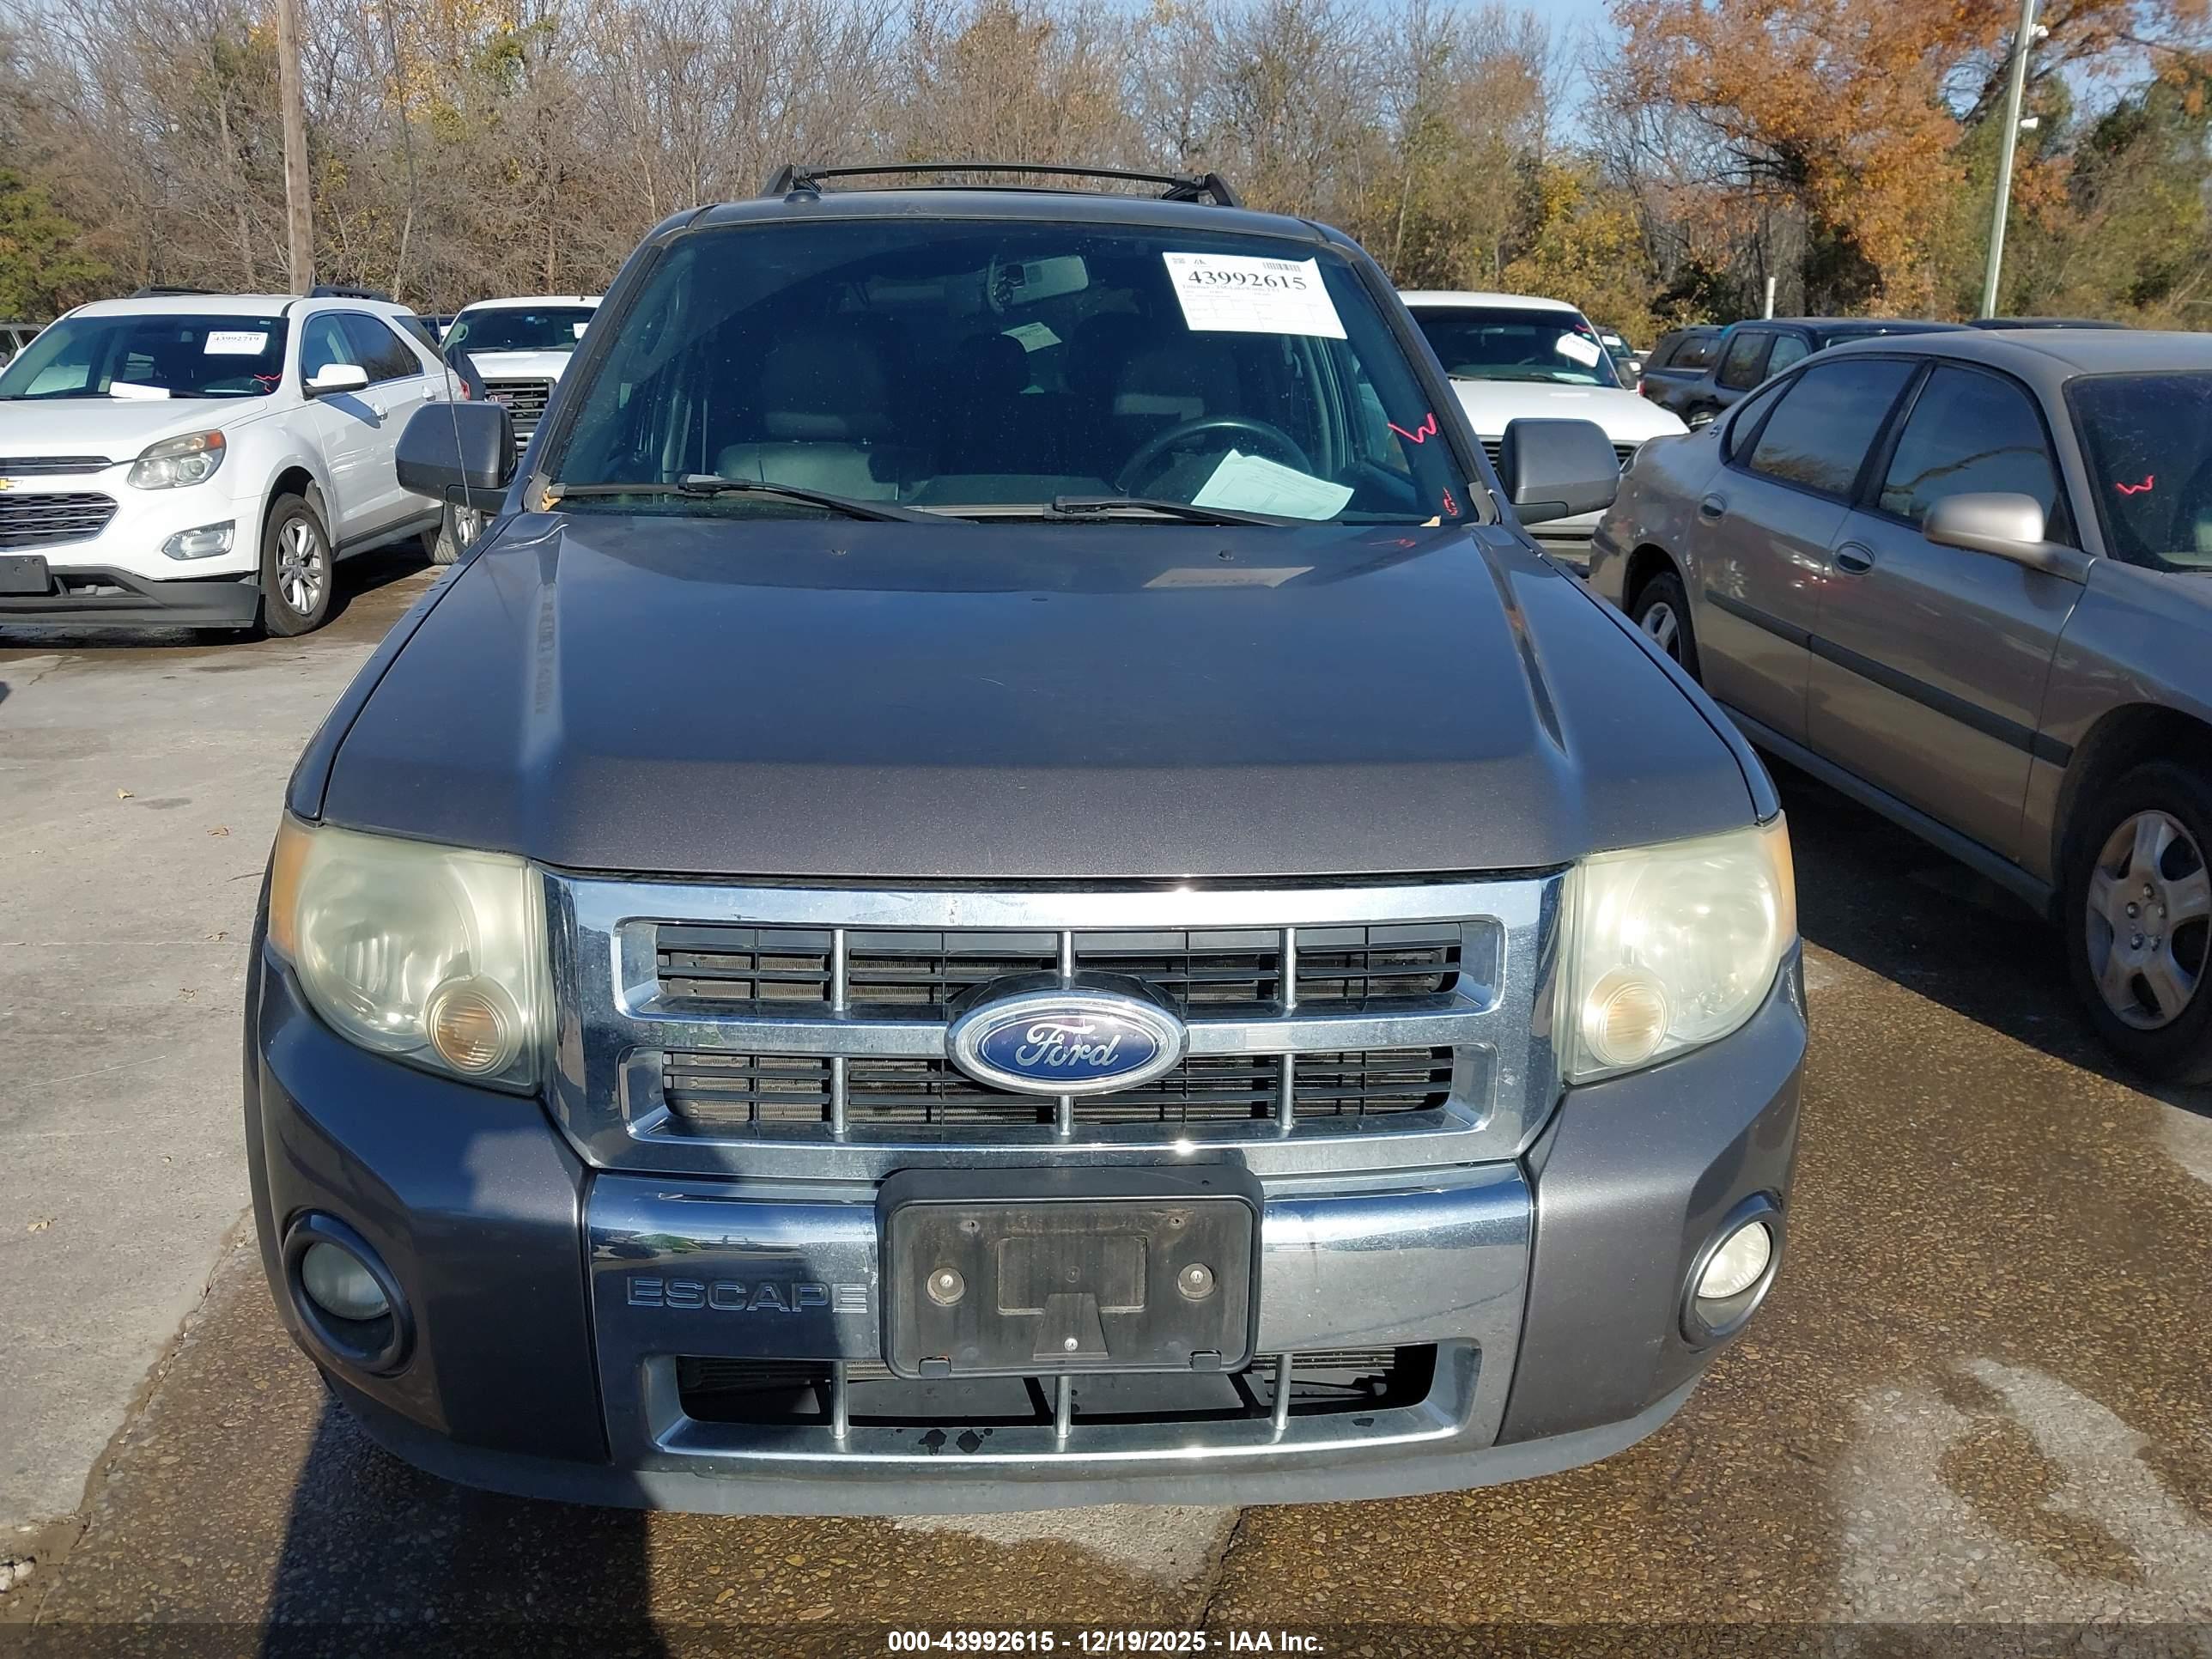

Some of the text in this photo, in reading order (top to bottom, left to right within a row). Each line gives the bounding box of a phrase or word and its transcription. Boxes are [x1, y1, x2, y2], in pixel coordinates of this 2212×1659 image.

[1188, 270, 1307, 290] 43992615
[1015, 1023, 1119, 1066] Ford
[627, 1276, 868, 1314] ESCAPE
